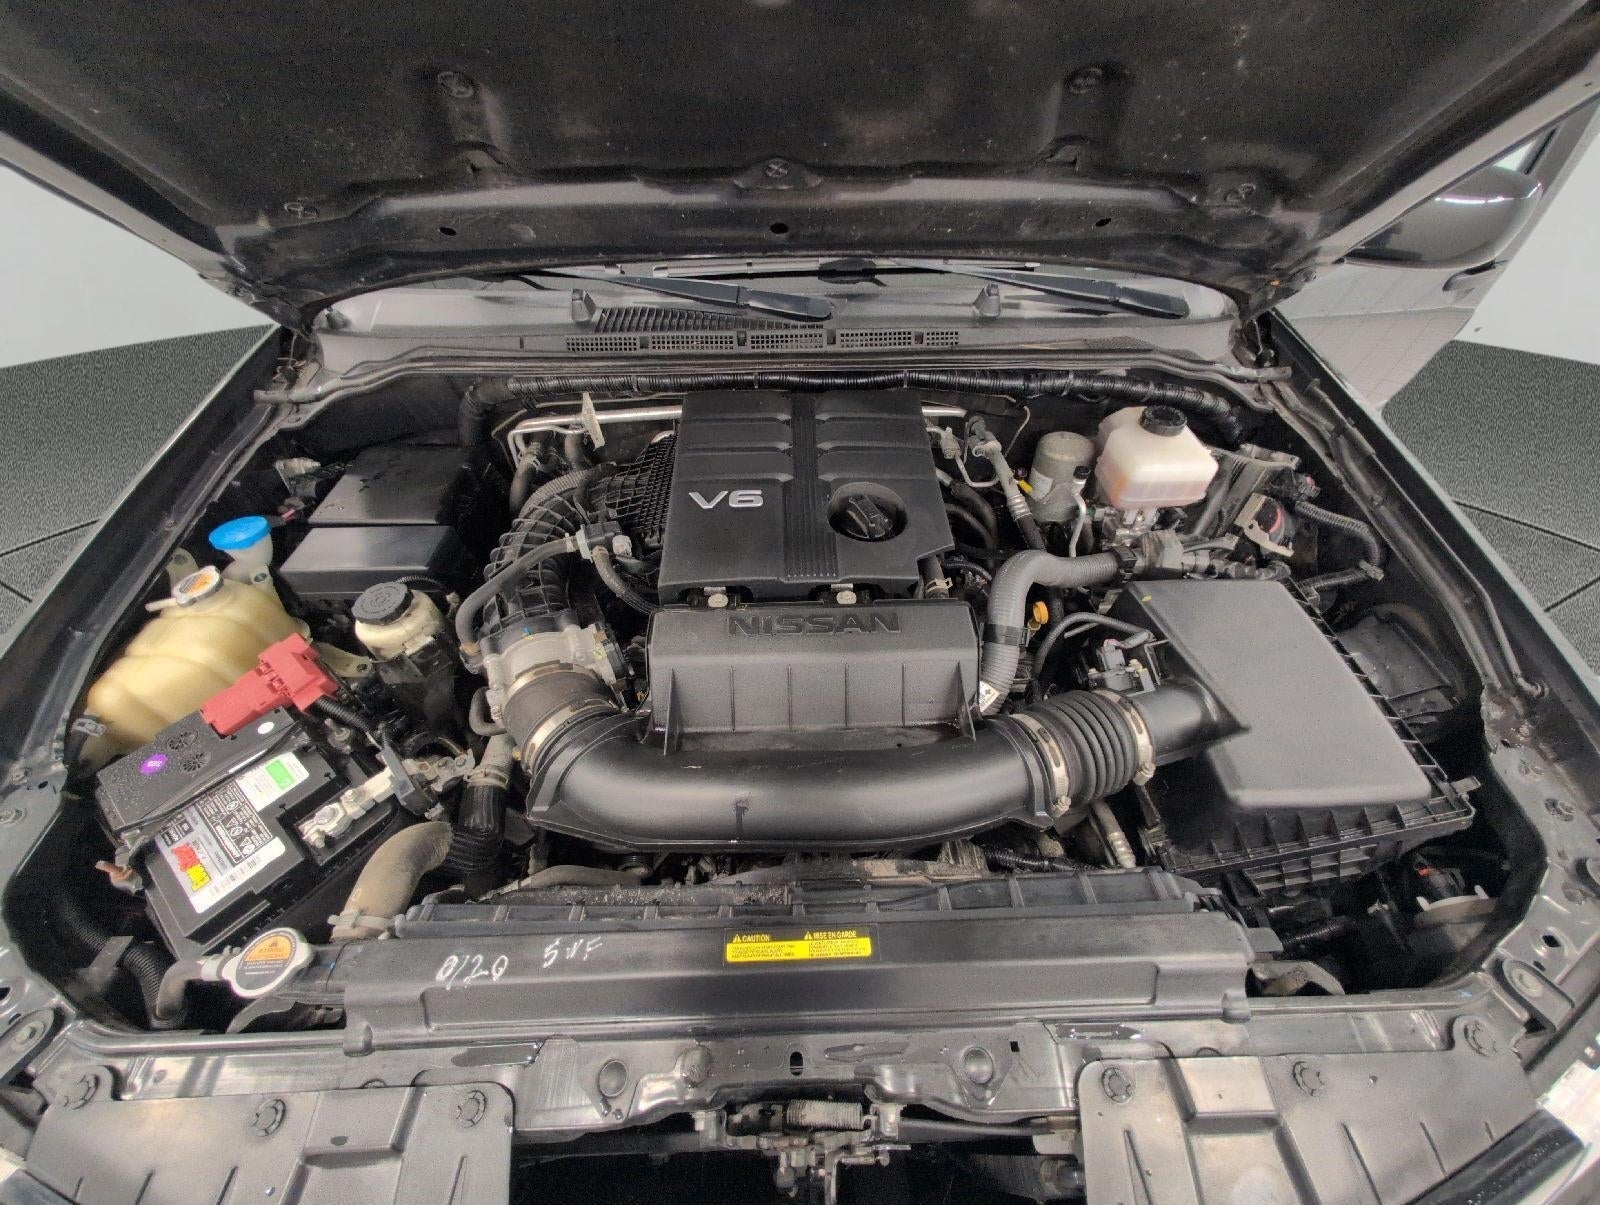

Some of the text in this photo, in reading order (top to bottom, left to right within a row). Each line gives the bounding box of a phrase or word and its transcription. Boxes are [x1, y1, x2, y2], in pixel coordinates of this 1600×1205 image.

[688, 489, 764, 510] V6
[727, 612, 902, 637] NISSAN
[742, 934, 770, 942] CAUTION
[813, 930, 857, 940] MISE EN GARDE
